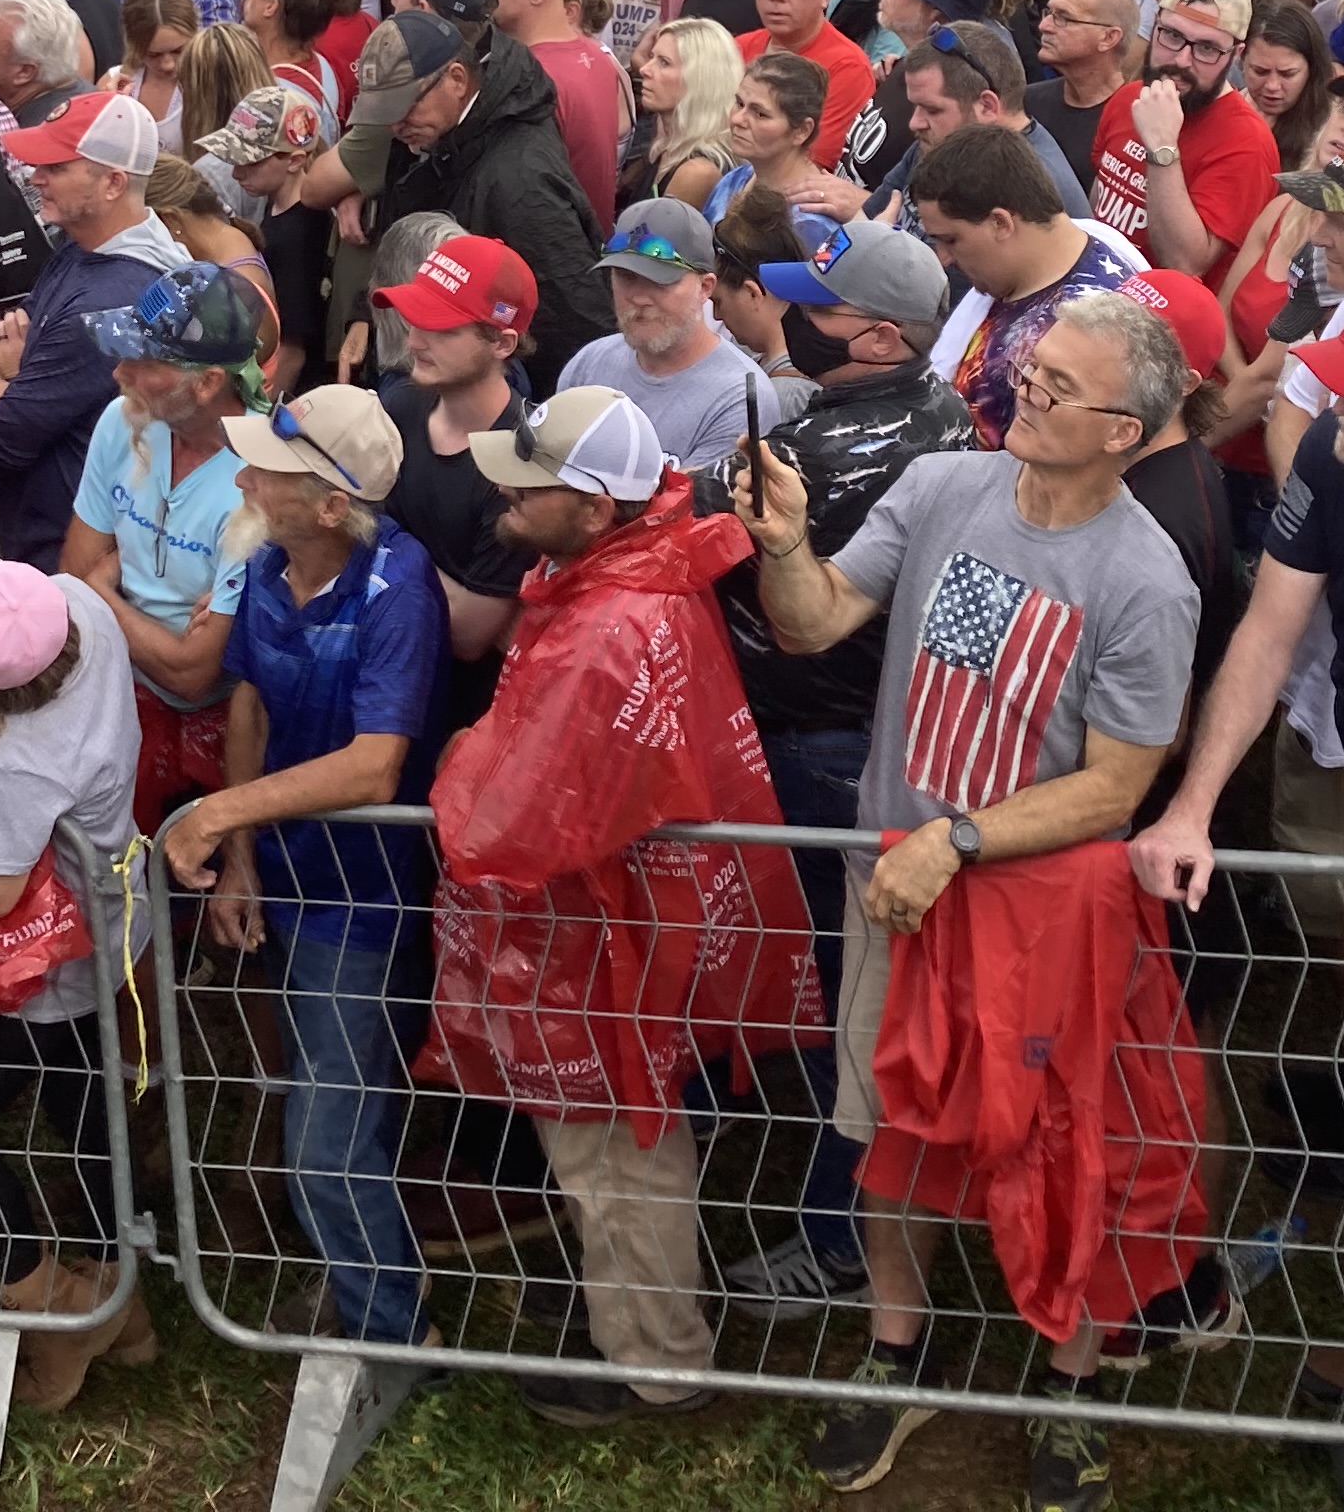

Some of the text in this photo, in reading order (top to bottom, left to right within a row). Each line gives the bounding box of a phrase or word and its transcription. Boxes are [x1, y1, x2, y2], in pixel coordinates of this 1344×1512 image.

[612, 22, 636, 37] 024
[615, 4, 657, 34] UMP
[427, 269, 462, 296] AGAIN!
[434, 255, 471, 285] AMERICA
[111, 485, 213, 557] Champion
[612, 658, 653, 732] TRUMP
[734, 728, 759, 751] Keep
[712, 859, 738, 892] 020
